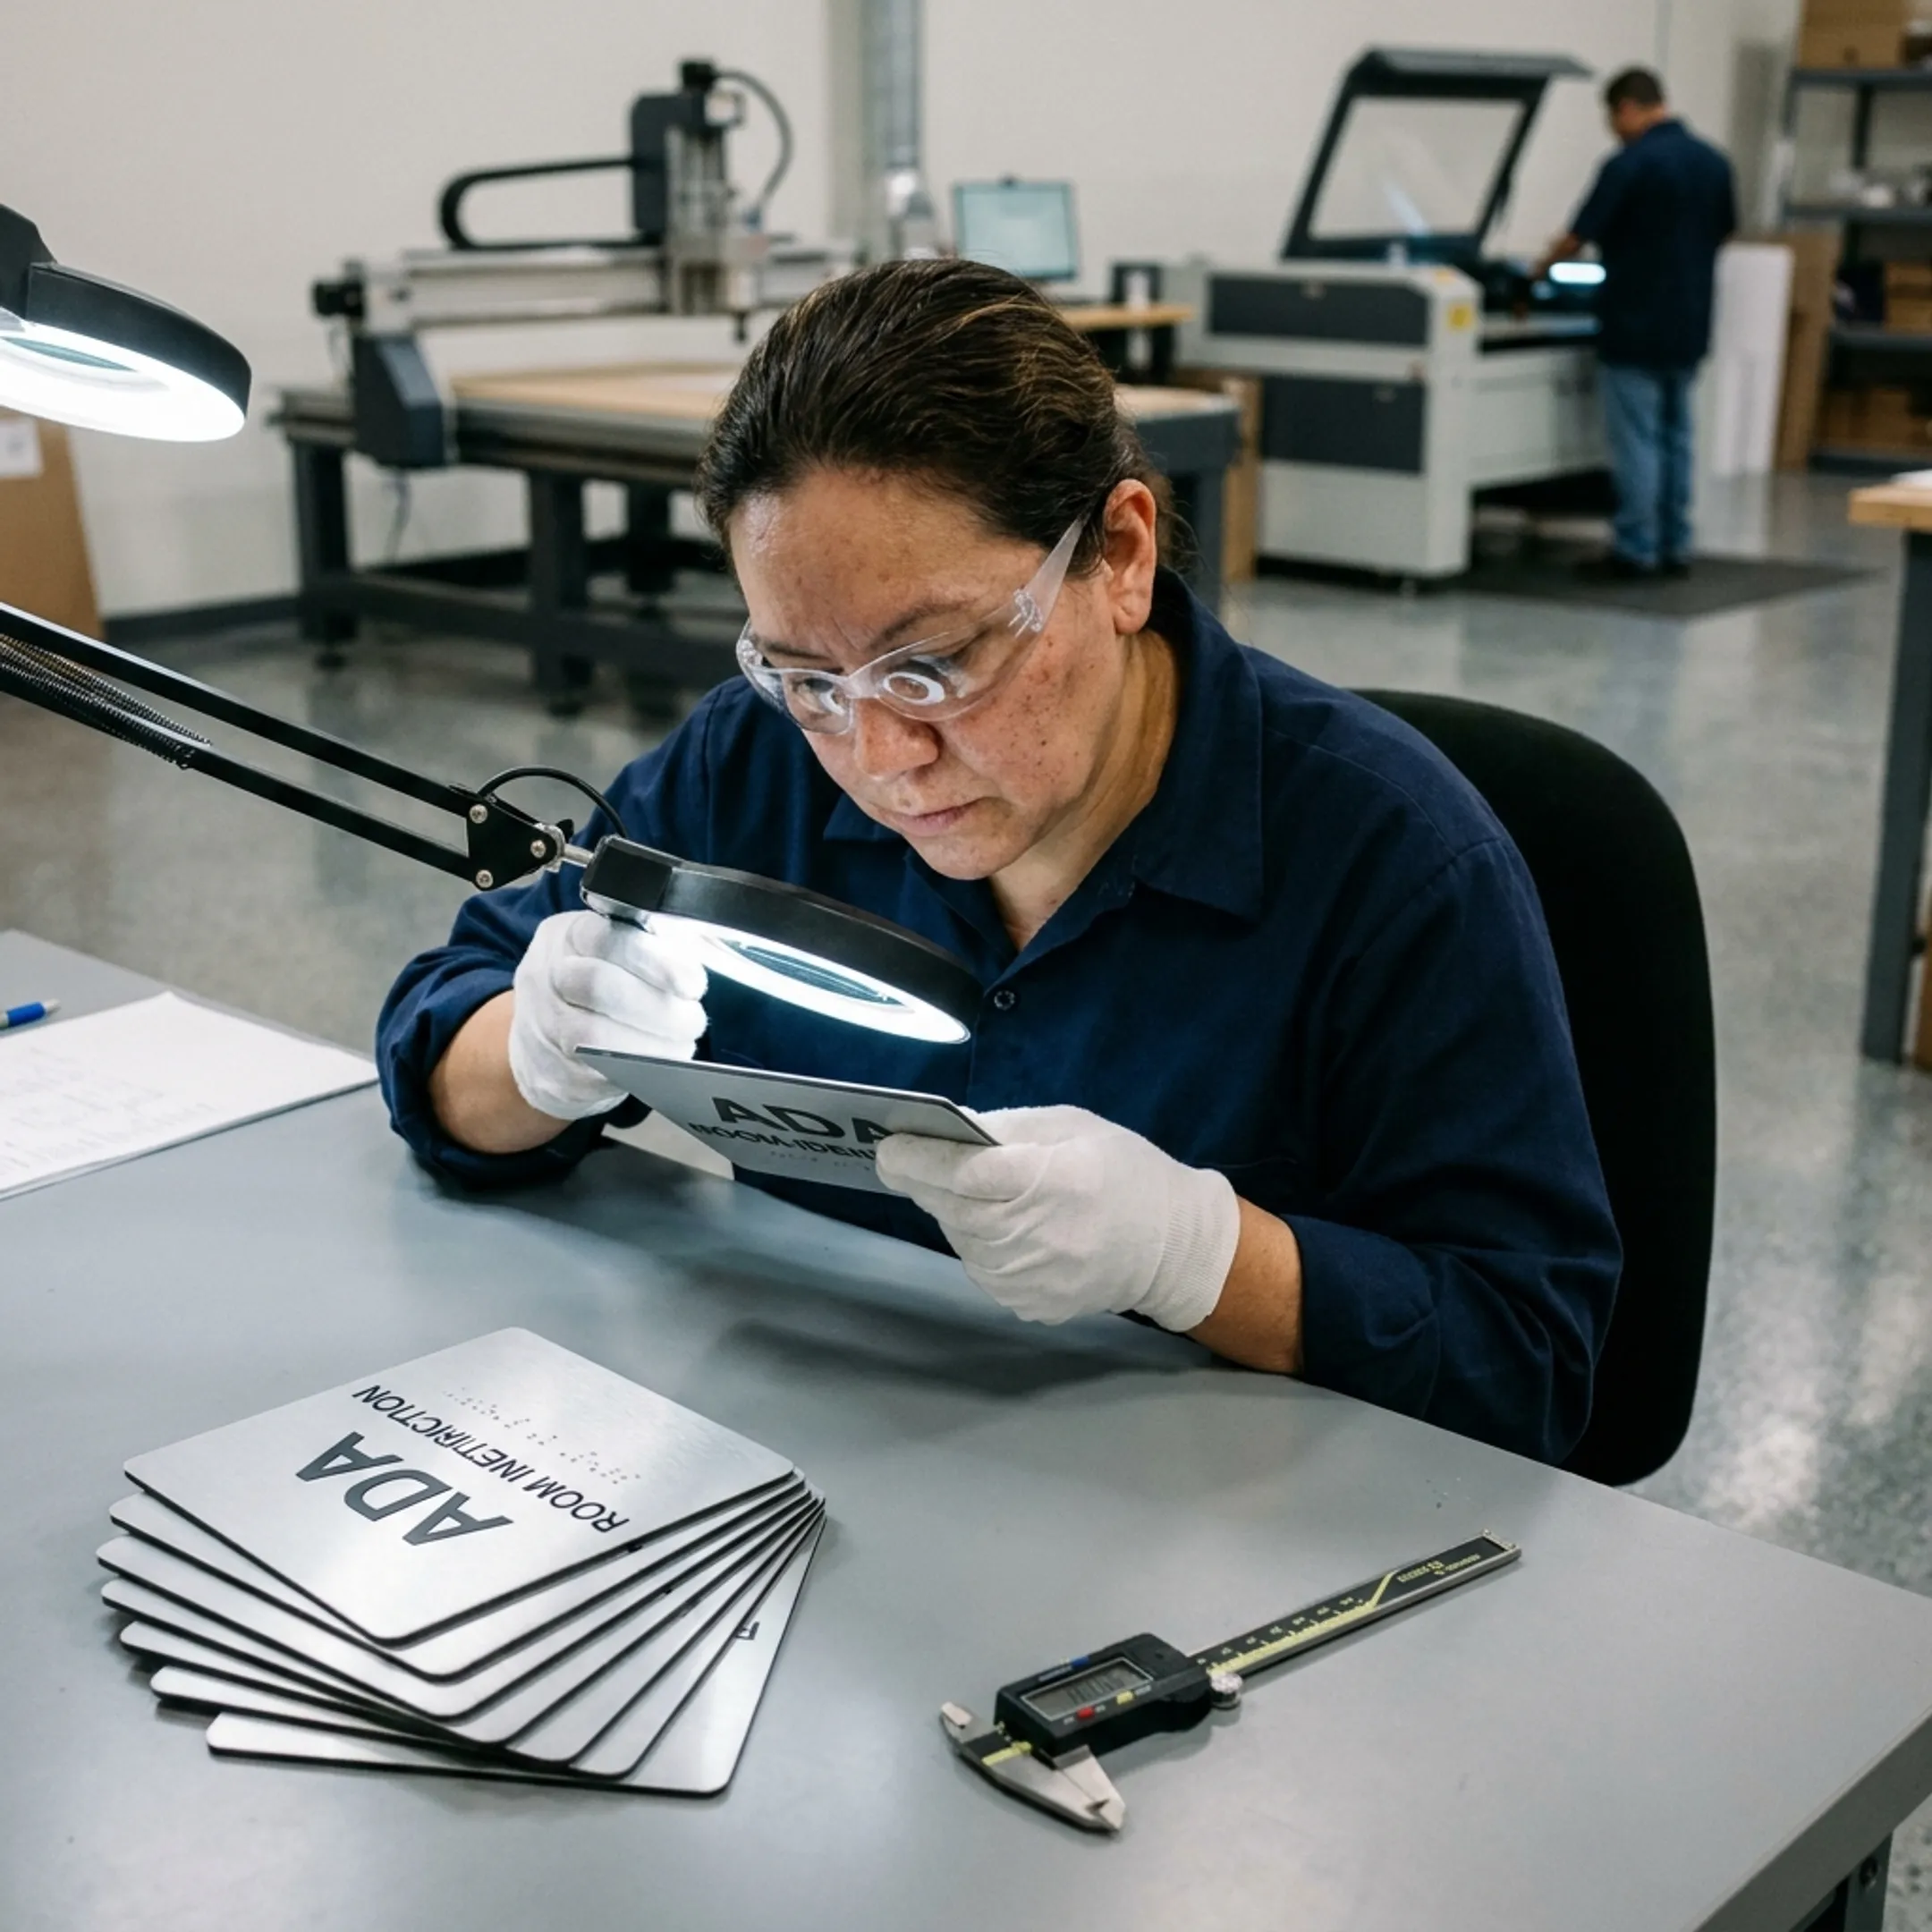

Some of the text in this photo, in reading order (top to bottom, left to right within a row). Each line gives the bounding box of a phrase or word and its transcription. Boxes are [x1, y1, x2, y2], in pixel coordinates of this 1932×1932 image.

[712, 1097, 895, 1144] ADA
[295, 1431, 514, 1546] ADA
[522, 1476, 630, 1532] ROOM
